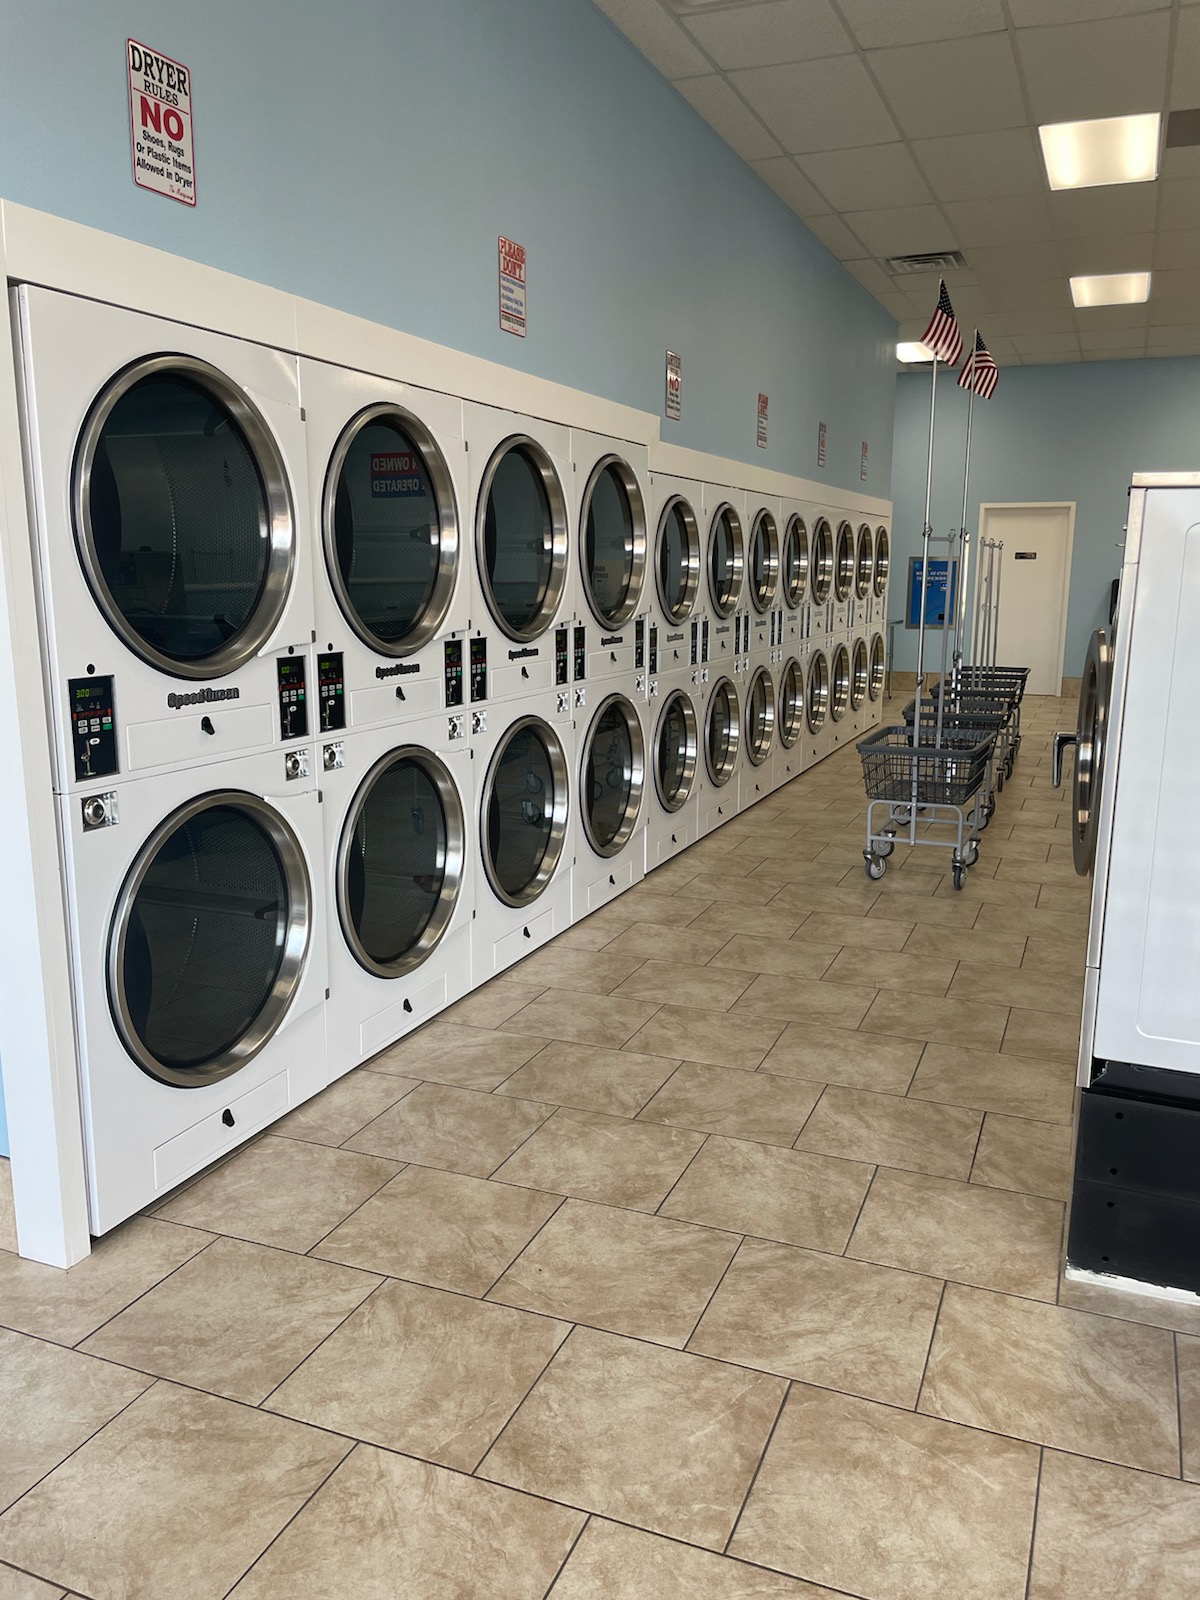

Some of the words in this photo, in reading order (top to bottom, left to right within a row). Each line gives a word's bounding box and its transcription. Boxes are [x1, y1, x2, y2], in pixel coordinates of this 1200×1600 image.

[130, 44, 188, 96] DRYER
[143, 79, 179, 106] RULES
[140, 95, 184, 142] NO
[136, 142, 145, 154] Or
[147, 146, 171, 165] Plastic
[172, 157, 192, 174] Items
[142, 129, 167, 151] Shoes,
[168, 140, 185, 158] Rugs
[136, 157, 165, 177] Allowed
[166, 168, 173, 181] in
[174, 172, 193, 189] Dryer
[669, 375, 680, 392] NO
